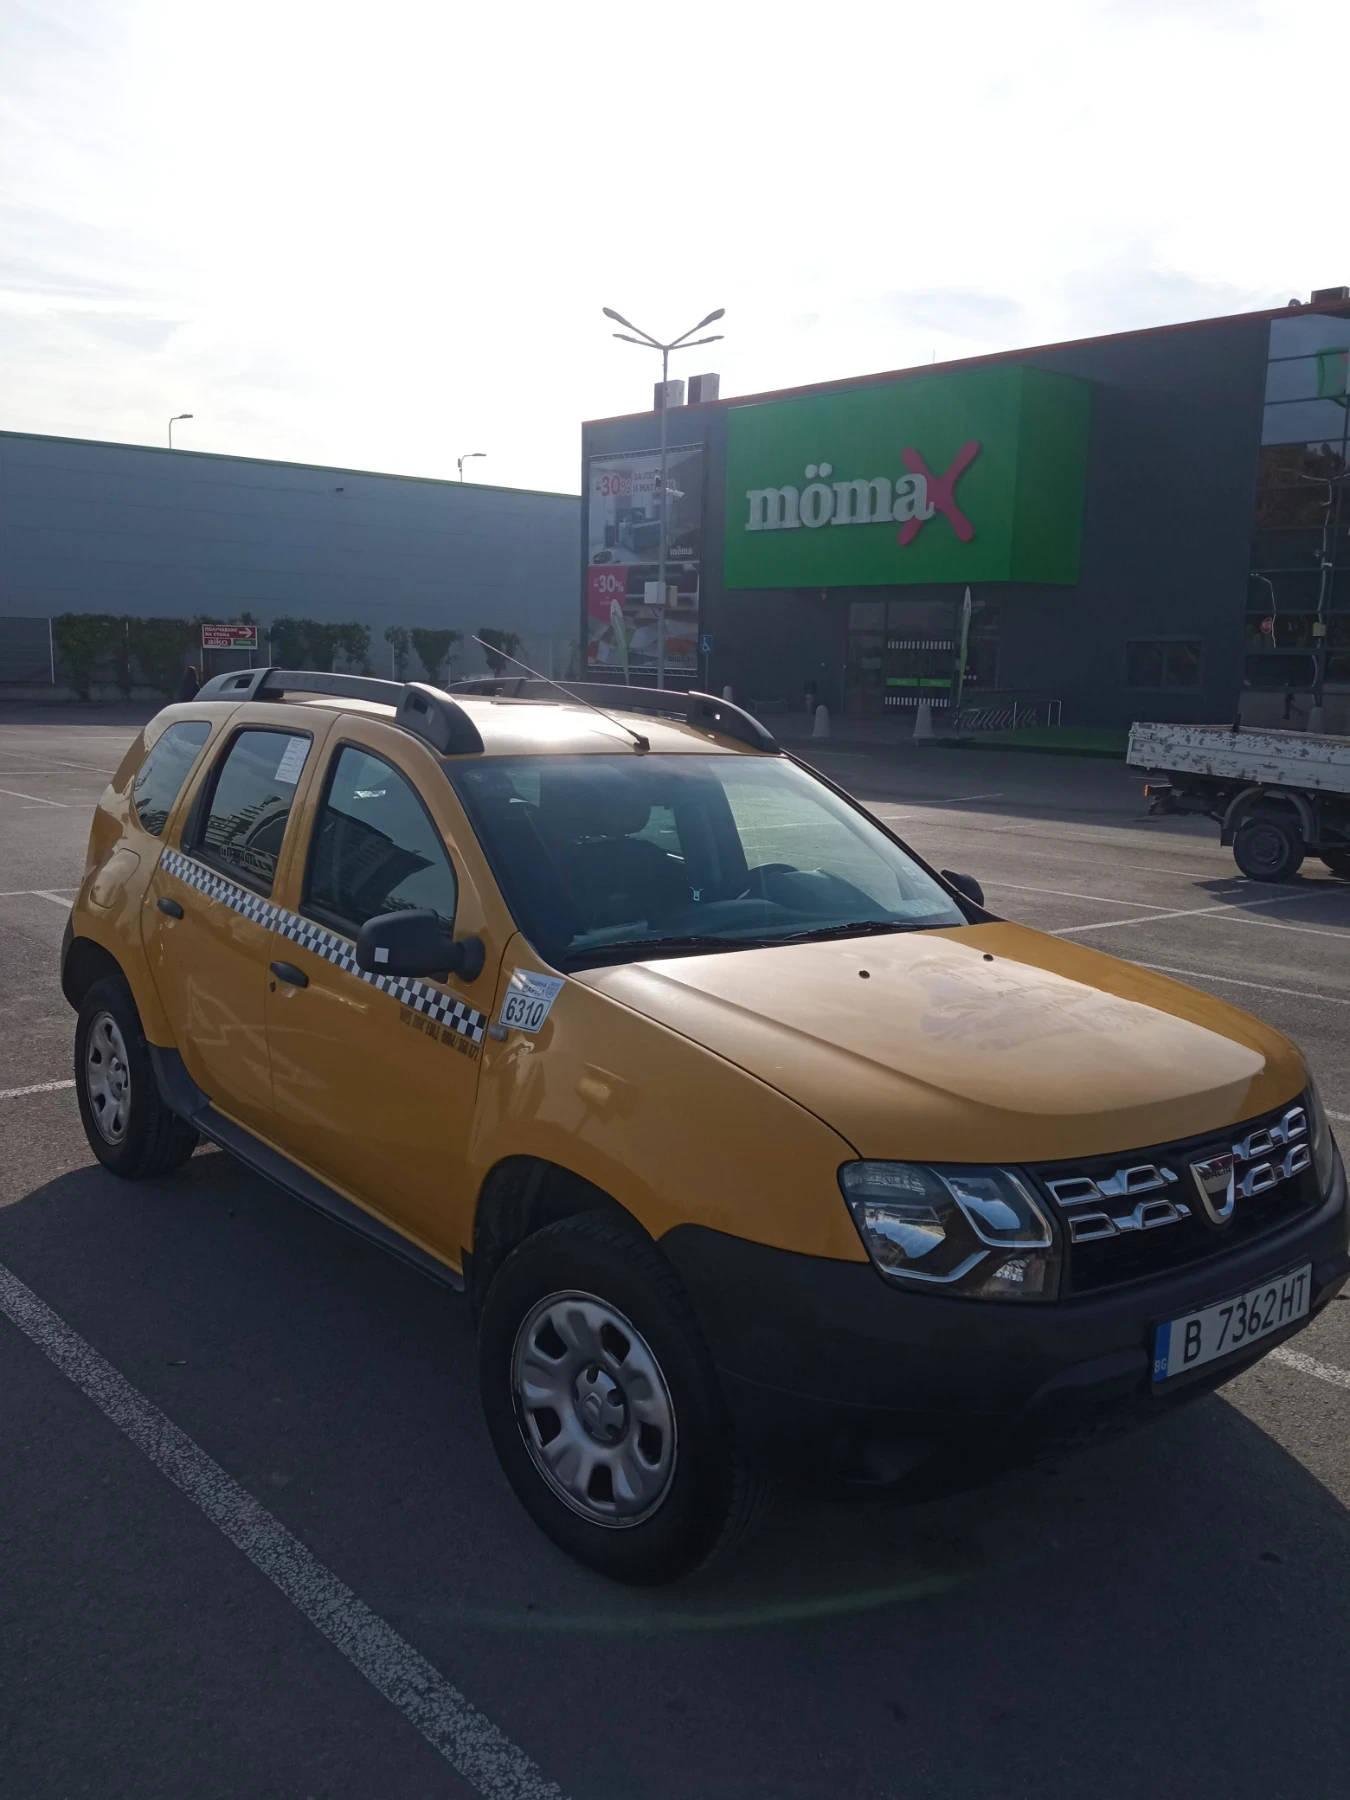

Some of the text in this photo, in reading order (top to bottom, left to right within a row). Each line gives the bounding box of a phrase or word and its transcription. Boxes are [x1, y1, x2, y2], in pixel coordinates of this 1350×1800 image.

[506, 997, 544, 1026] 6310
[1183, 1319, 1202, 1364] B
[1154, 1359, 1168, 1373] BG
